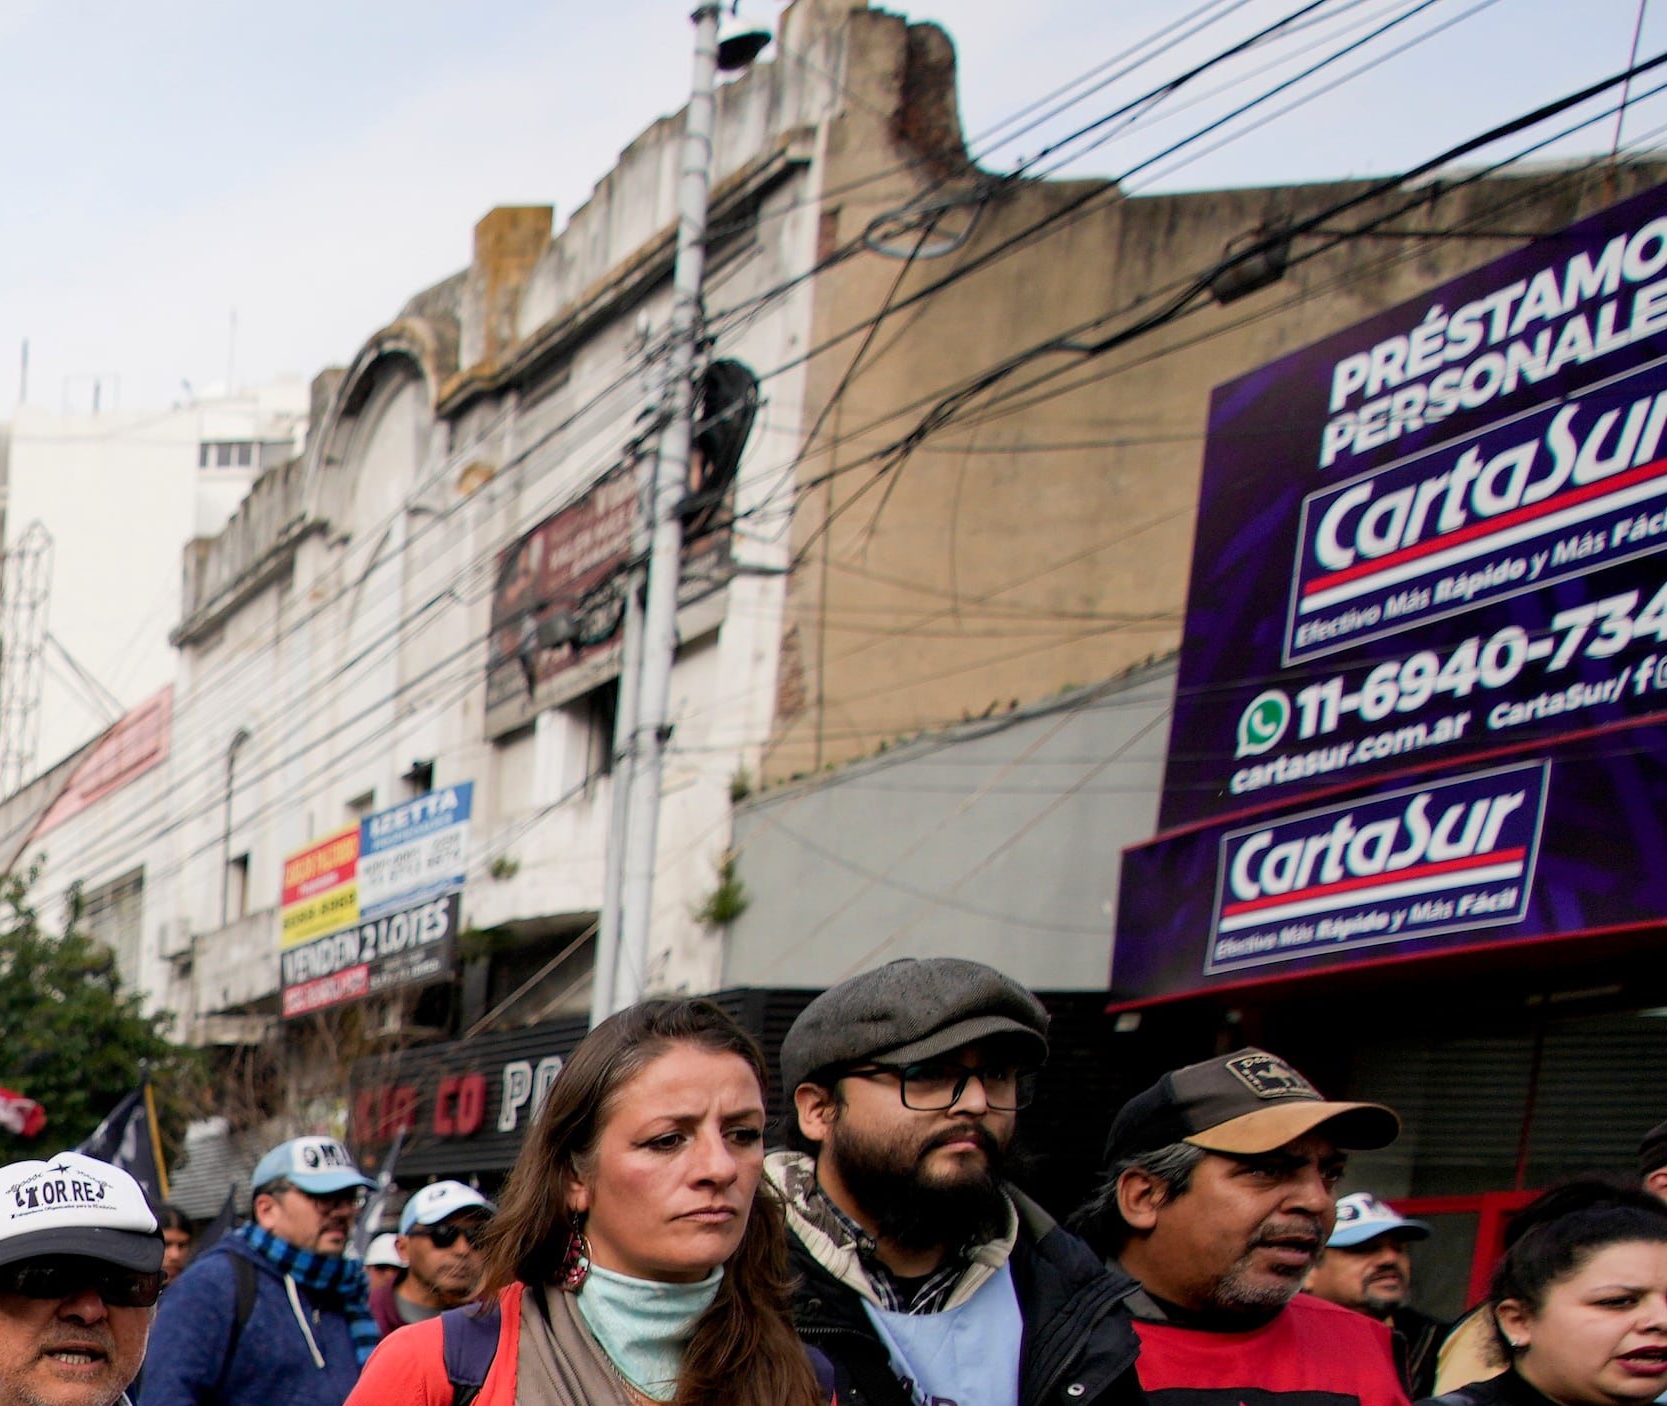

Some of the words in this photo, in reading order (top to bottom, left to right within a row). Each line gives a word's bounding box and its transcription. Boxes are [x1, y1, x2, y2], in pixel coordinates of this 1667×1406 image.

[1294, 604, 1382, 649] Efectivo
[1383, 586, 1432, 622] Más
[1433, 557, 1528, 605] Rápido
[1526, 549, 1549, 582] y
[1550, 531, 1608, 569] Más
[1230, 711, 1471, 796] cartasur.com.ar
[1229, 789, 1526, 901] CartaSur
[1316, 908, 1390, 941] Rápido
[1389, 907, 1409, 933] y
[1407, 898, 1456, 926] Más
[1455, 886, 1519, 918] Fácil
